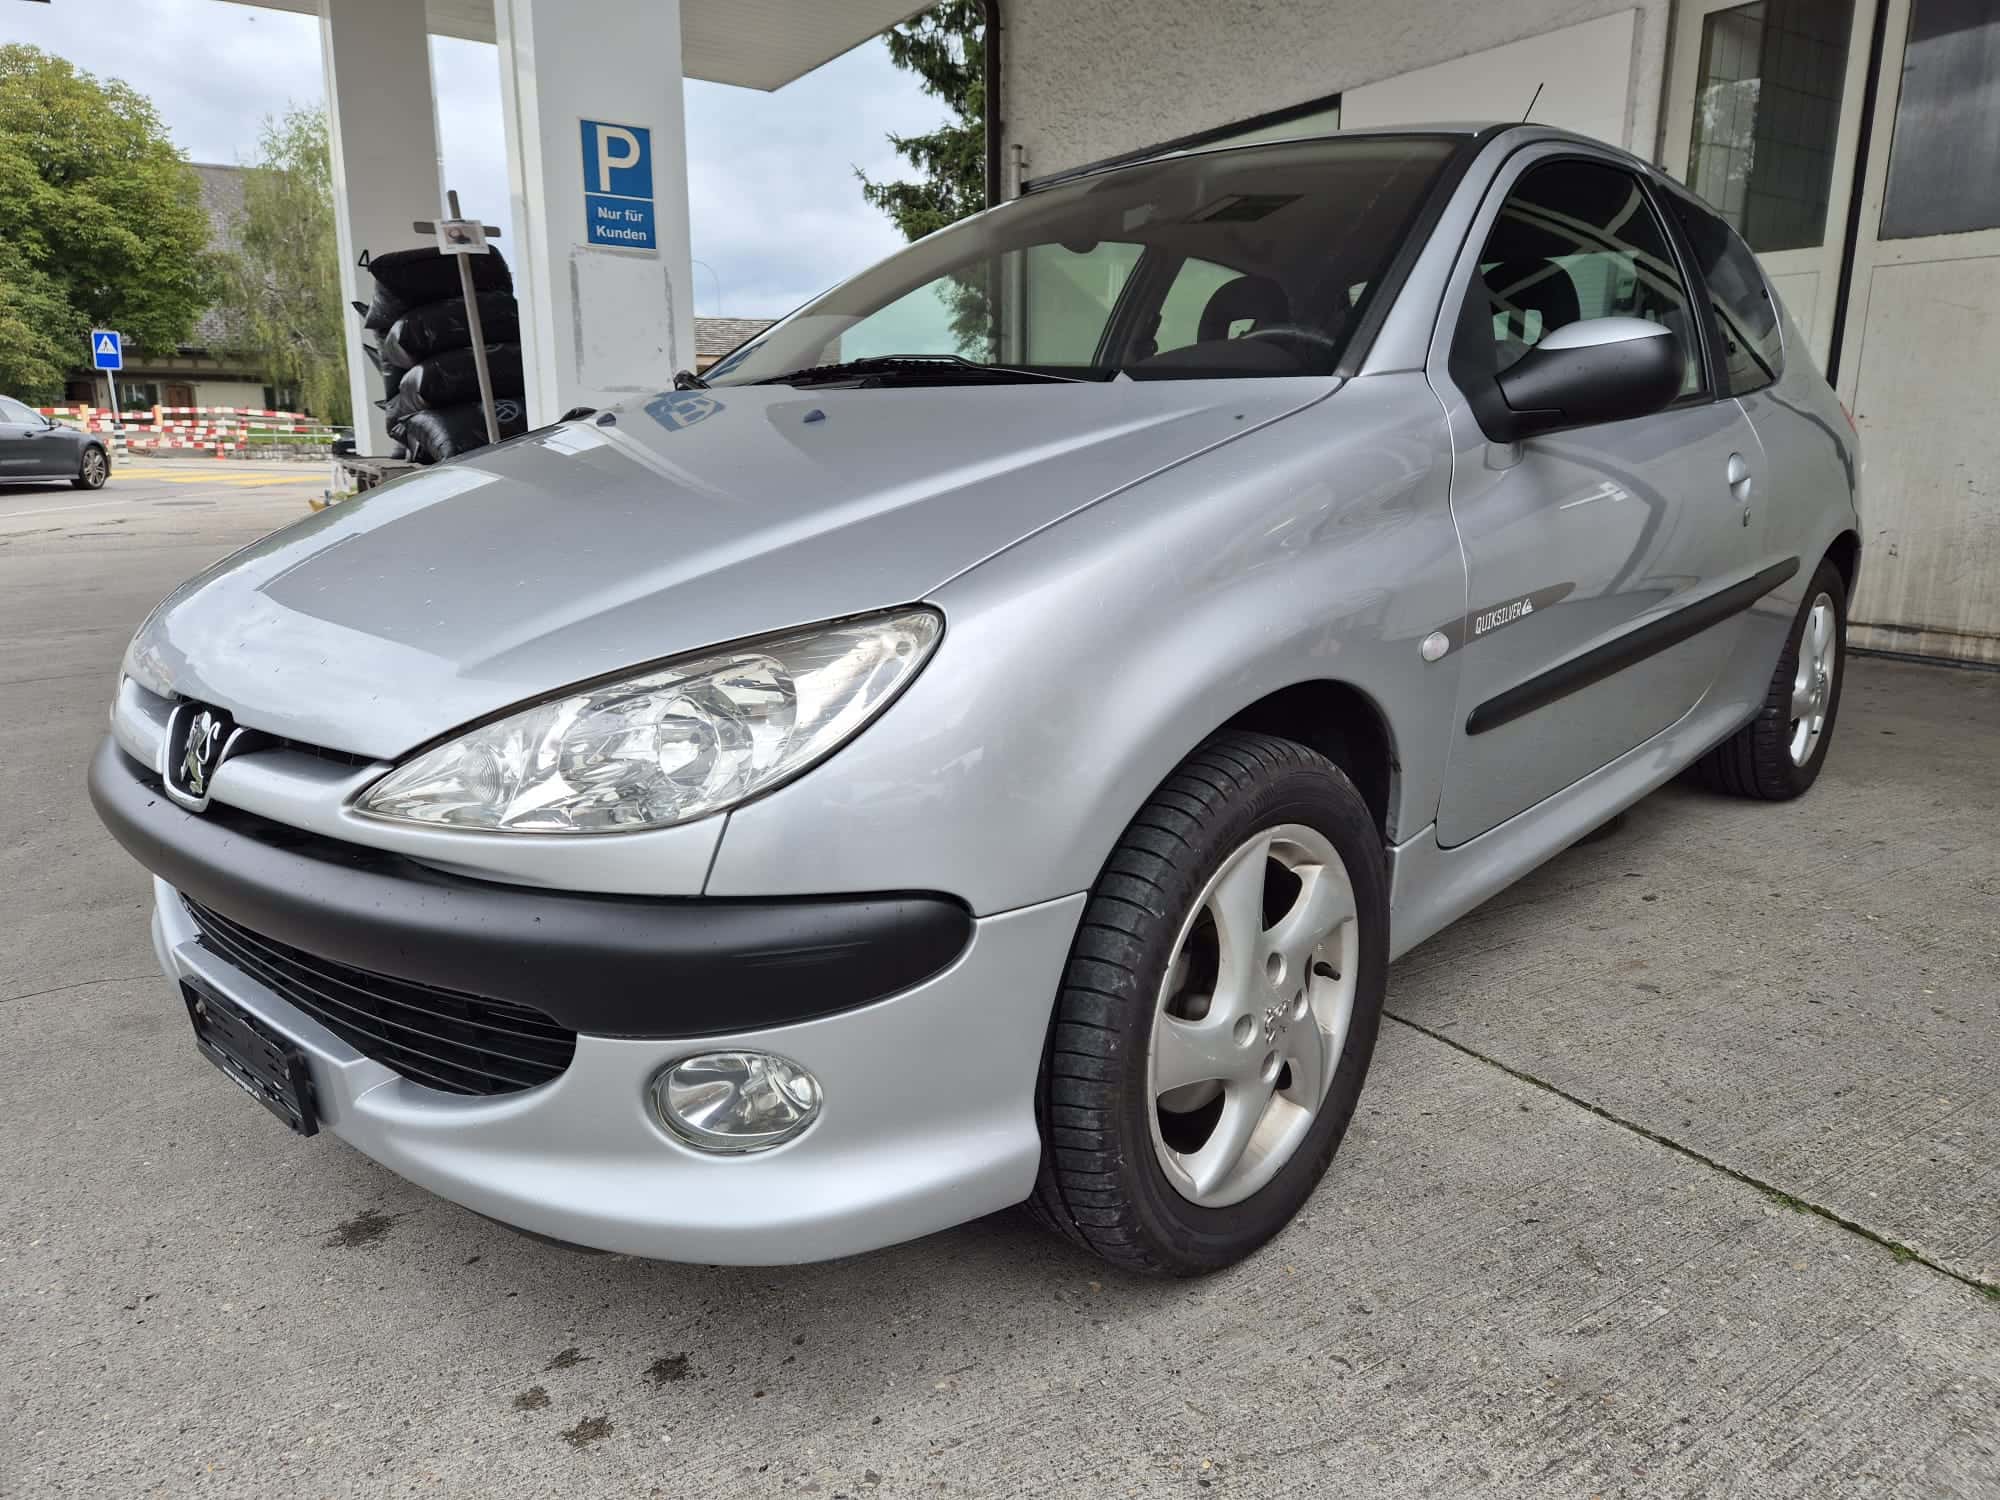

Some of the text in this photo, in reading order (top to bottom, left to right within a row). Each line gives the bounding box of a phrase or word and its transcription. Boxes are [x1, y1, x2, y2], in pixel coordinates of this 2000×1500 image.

[596, 124, 640, 192] P
[597, 206, 644, 222] Nur für
[596, 225, 647, 241] Kunden
[1475, 601, 1522, 635] QUIKSILVER
